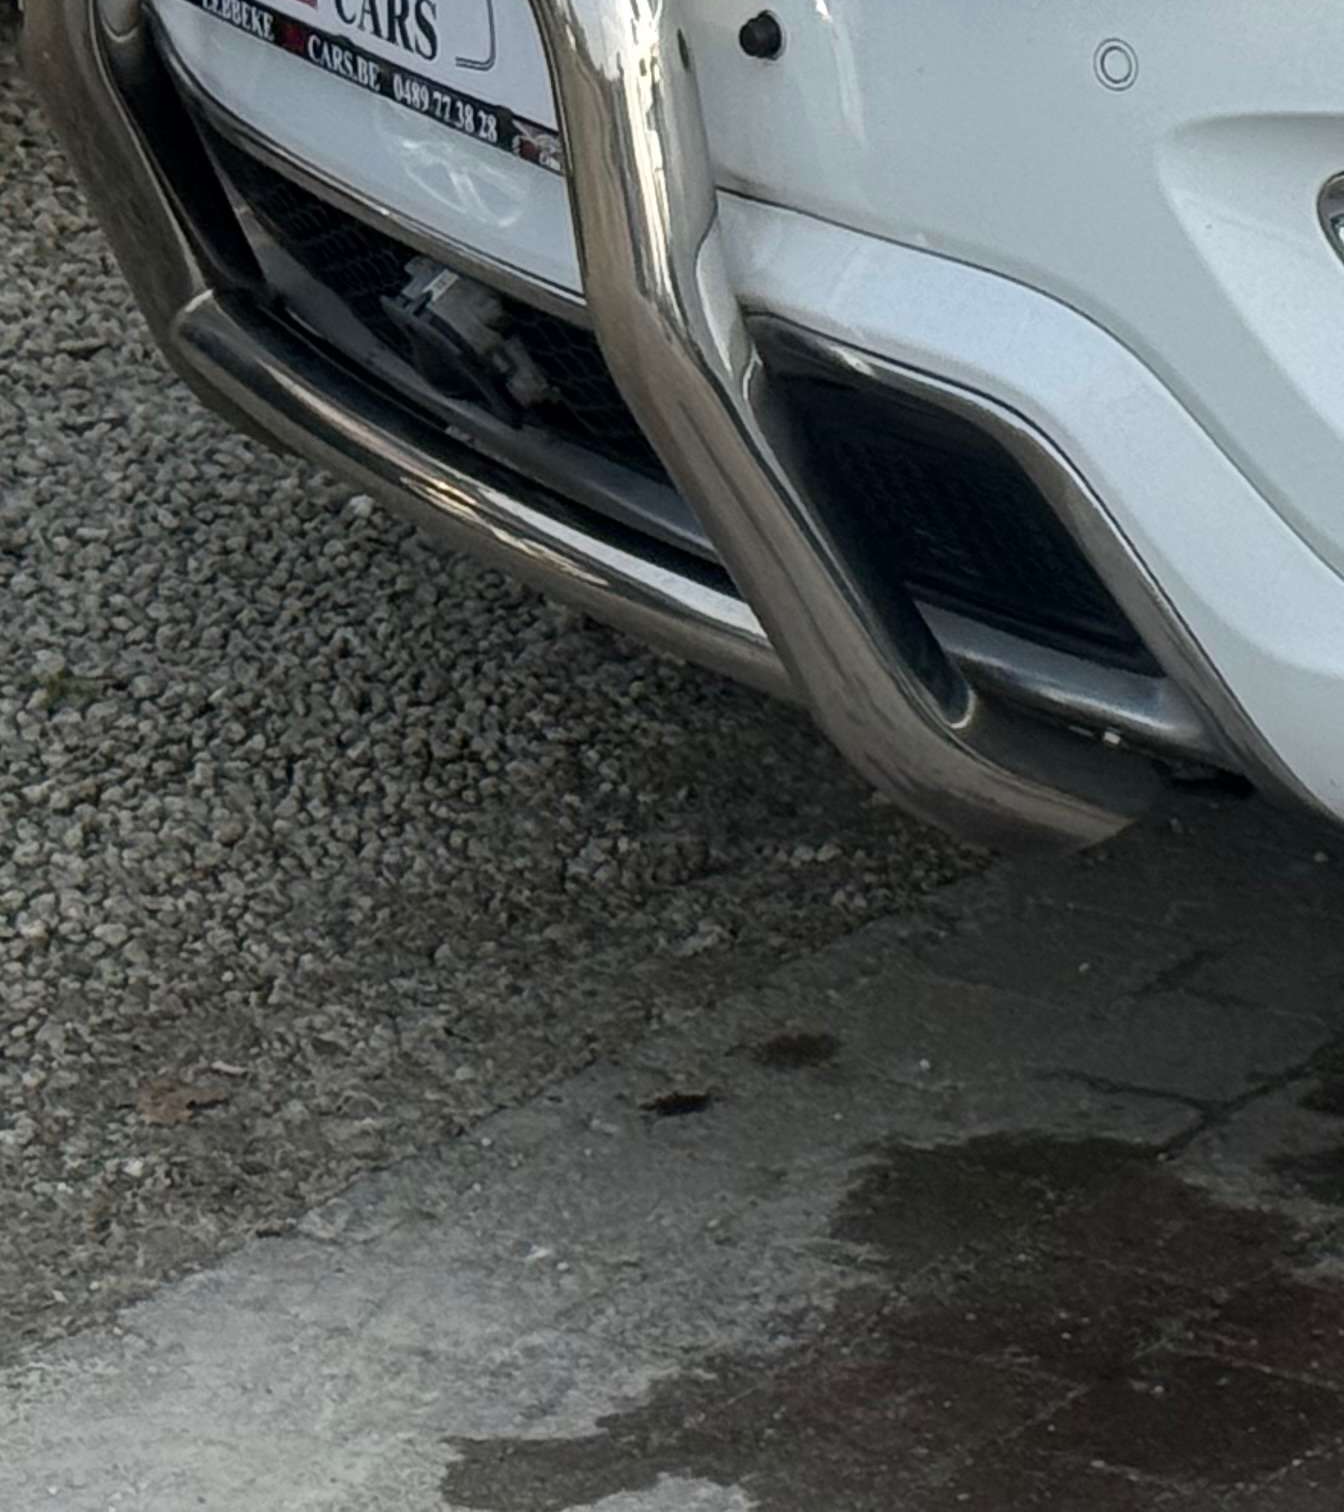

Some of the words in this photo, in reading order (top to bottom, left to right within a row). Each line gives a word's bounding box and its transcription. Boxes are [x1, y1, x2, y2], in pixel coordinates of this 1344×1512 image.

[307, 34, 381, 91] CARS.BE
[393, 73, 429, 111] 0489
[432, 90, 451, 121] 77
[455, 99, 475, 133] 38
[478, 110, 498, 143] 28
